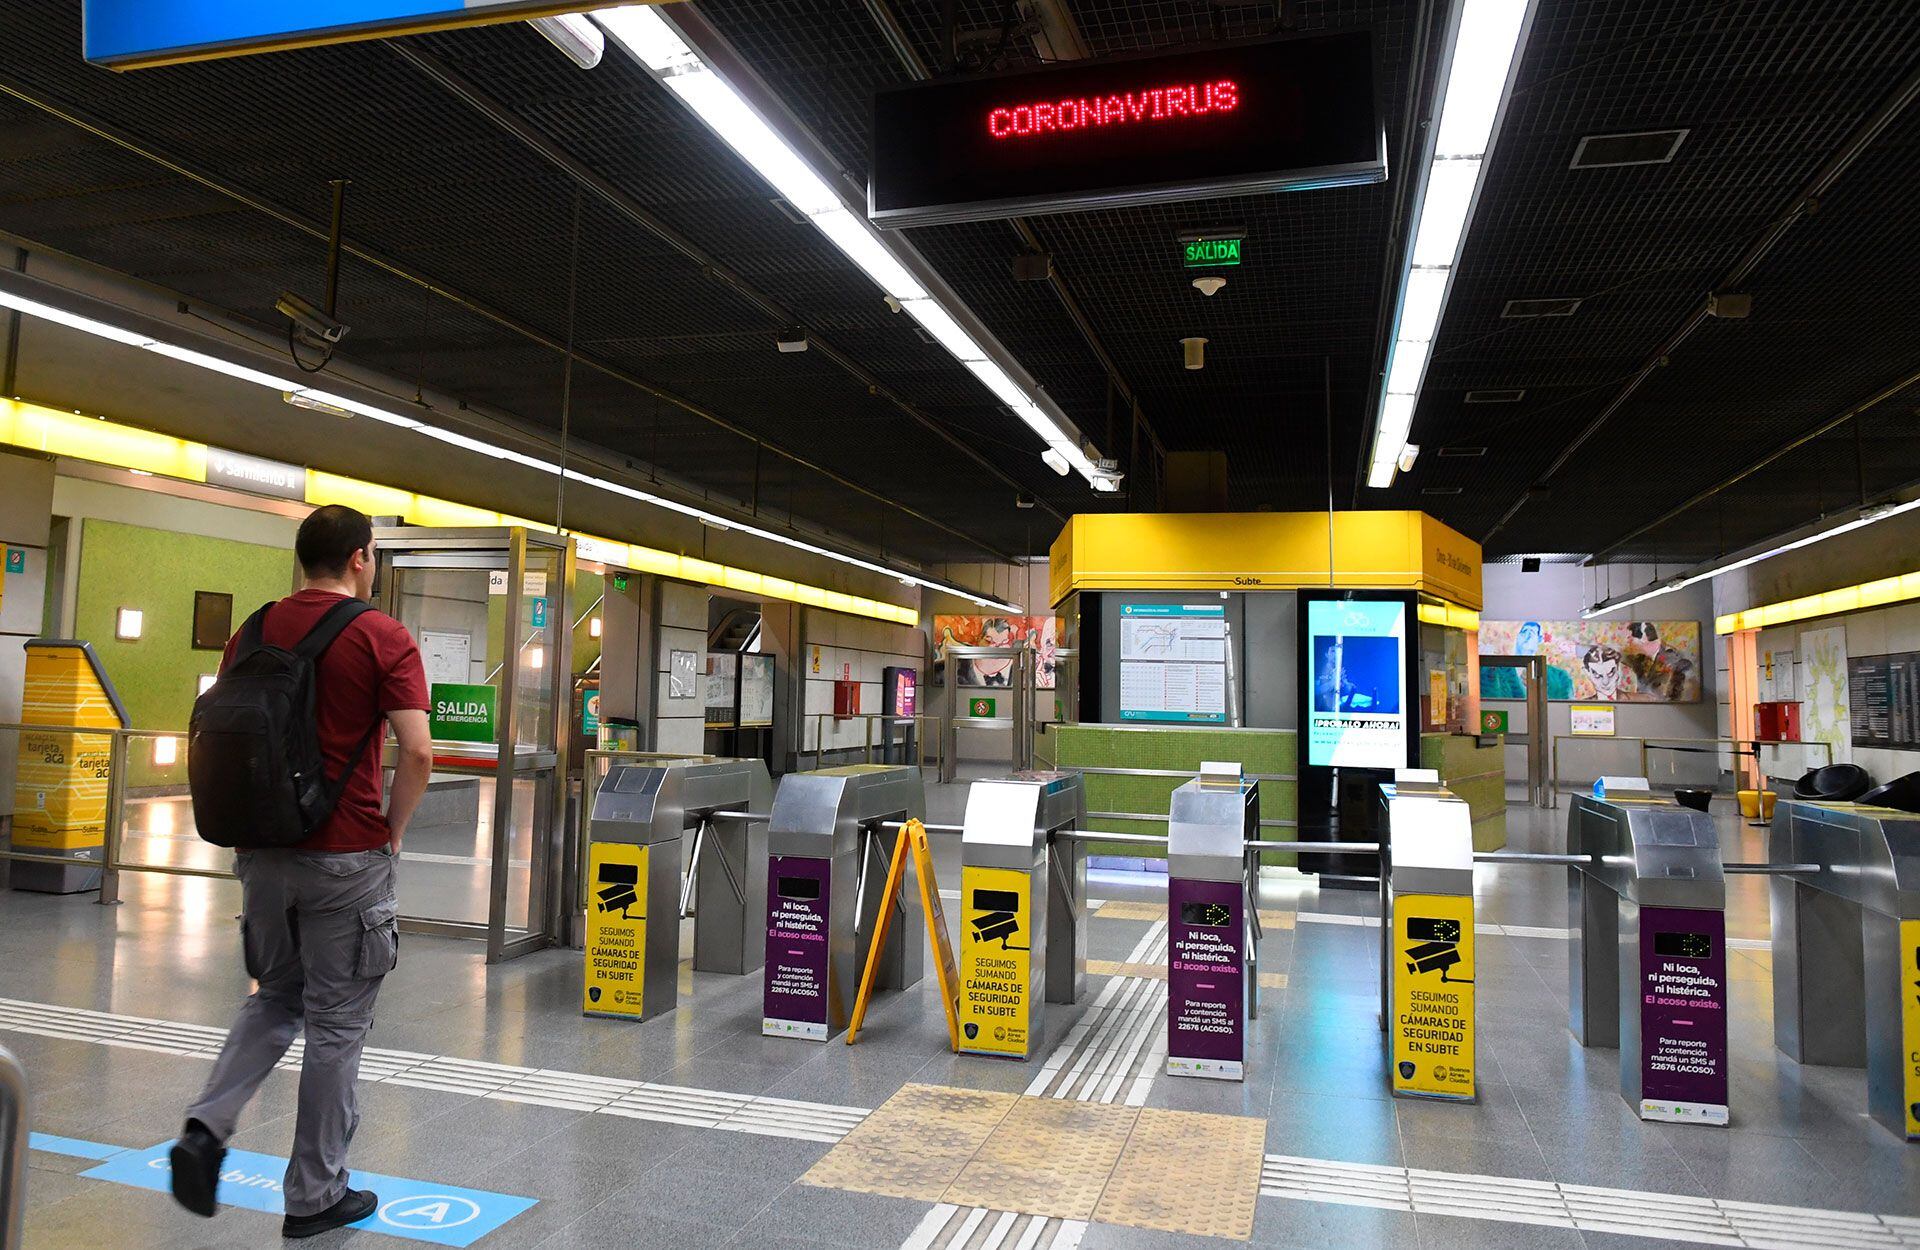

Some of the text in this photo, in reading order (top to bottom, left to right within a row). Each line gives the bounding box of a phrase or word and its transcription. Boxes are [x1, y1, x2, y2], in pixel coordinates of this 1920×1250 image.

[989, 80, 1237, 138] CORONAVIRUS
[1186, 244, 1238, 261] SALIDA
[1234, 576, 1262, 586] Subte
[436, 700, 488, 716] SALIDA
[446, 715, 488, 724] EMERGENCIA
[28, 742, 59, 755] tarjeta
[80, 758, 110, 770] tarjeta
[793, 903, 810, 912] loca,
[780, 911, 823, 923] perseguida,
[784, 920, 817, 931] histérica.
[600, 927, 635, 937] SEGUIMOS
[778, 931, 800, 939] acoso
[801, 932, 824, 941] existe.
[1189, 932, 1221, 942] Ni loca,
[599, 937, 634, 947] SUMANDO
[1185, 942, 1236, 954] perseguida,
[592, 946, 639, 959] CÁMARAS DE
[1191, 952, 1230, 963] histérica.
[593, 958, 637, 970] SEGURIDAD
[976, 958, 1016, 969] SEGUIMOS
[1173, 961, 1239, 974] El acoso existe.
[1663, 963, 1700, 975] Ni loca,
[597, 970, 634, 981] EN SUBTE
[975, 969, 1016, 980] SUMANDO
[1648, 973, 1718, 988] ni perseguida,
[966, 978, 1022, 993] CÁMARAS DE
[1655, 985, 1711, 997] ni histérica.
[969, 992, 1020, 1005] SEGURIDAD
[1411, 990, 1458, 1004] SEGUIMOS
[1646, 995, 1721, 1010] El acoso existe.
[973, 1005, 1016, 1017] EN SUBTE
[1185, 1000, 1226, 1010] Para reporte
[1410, 1003, 1458, 1016] SUMANDO
[1190, 1008, 1227, 1017] contención
[1401, 1013, 1466, 1030] CÁMARAS DE
[1403, 1028, 1463, 1042] SEGURIDAD
[1409, 1041, 1459, 1055] EN SUBTE
[1660, 1037, 1707, 1048] Para reporte
[1665, 1046, 1707, 1056] contención
[1651, 1054, 1678, 1063] mandá
[1690, 1057, 1707, 1066] SMS
[1651, 1062, 1715, 1075] 22676 (ACOSO).
[396, 1202, 450, 1222] A
